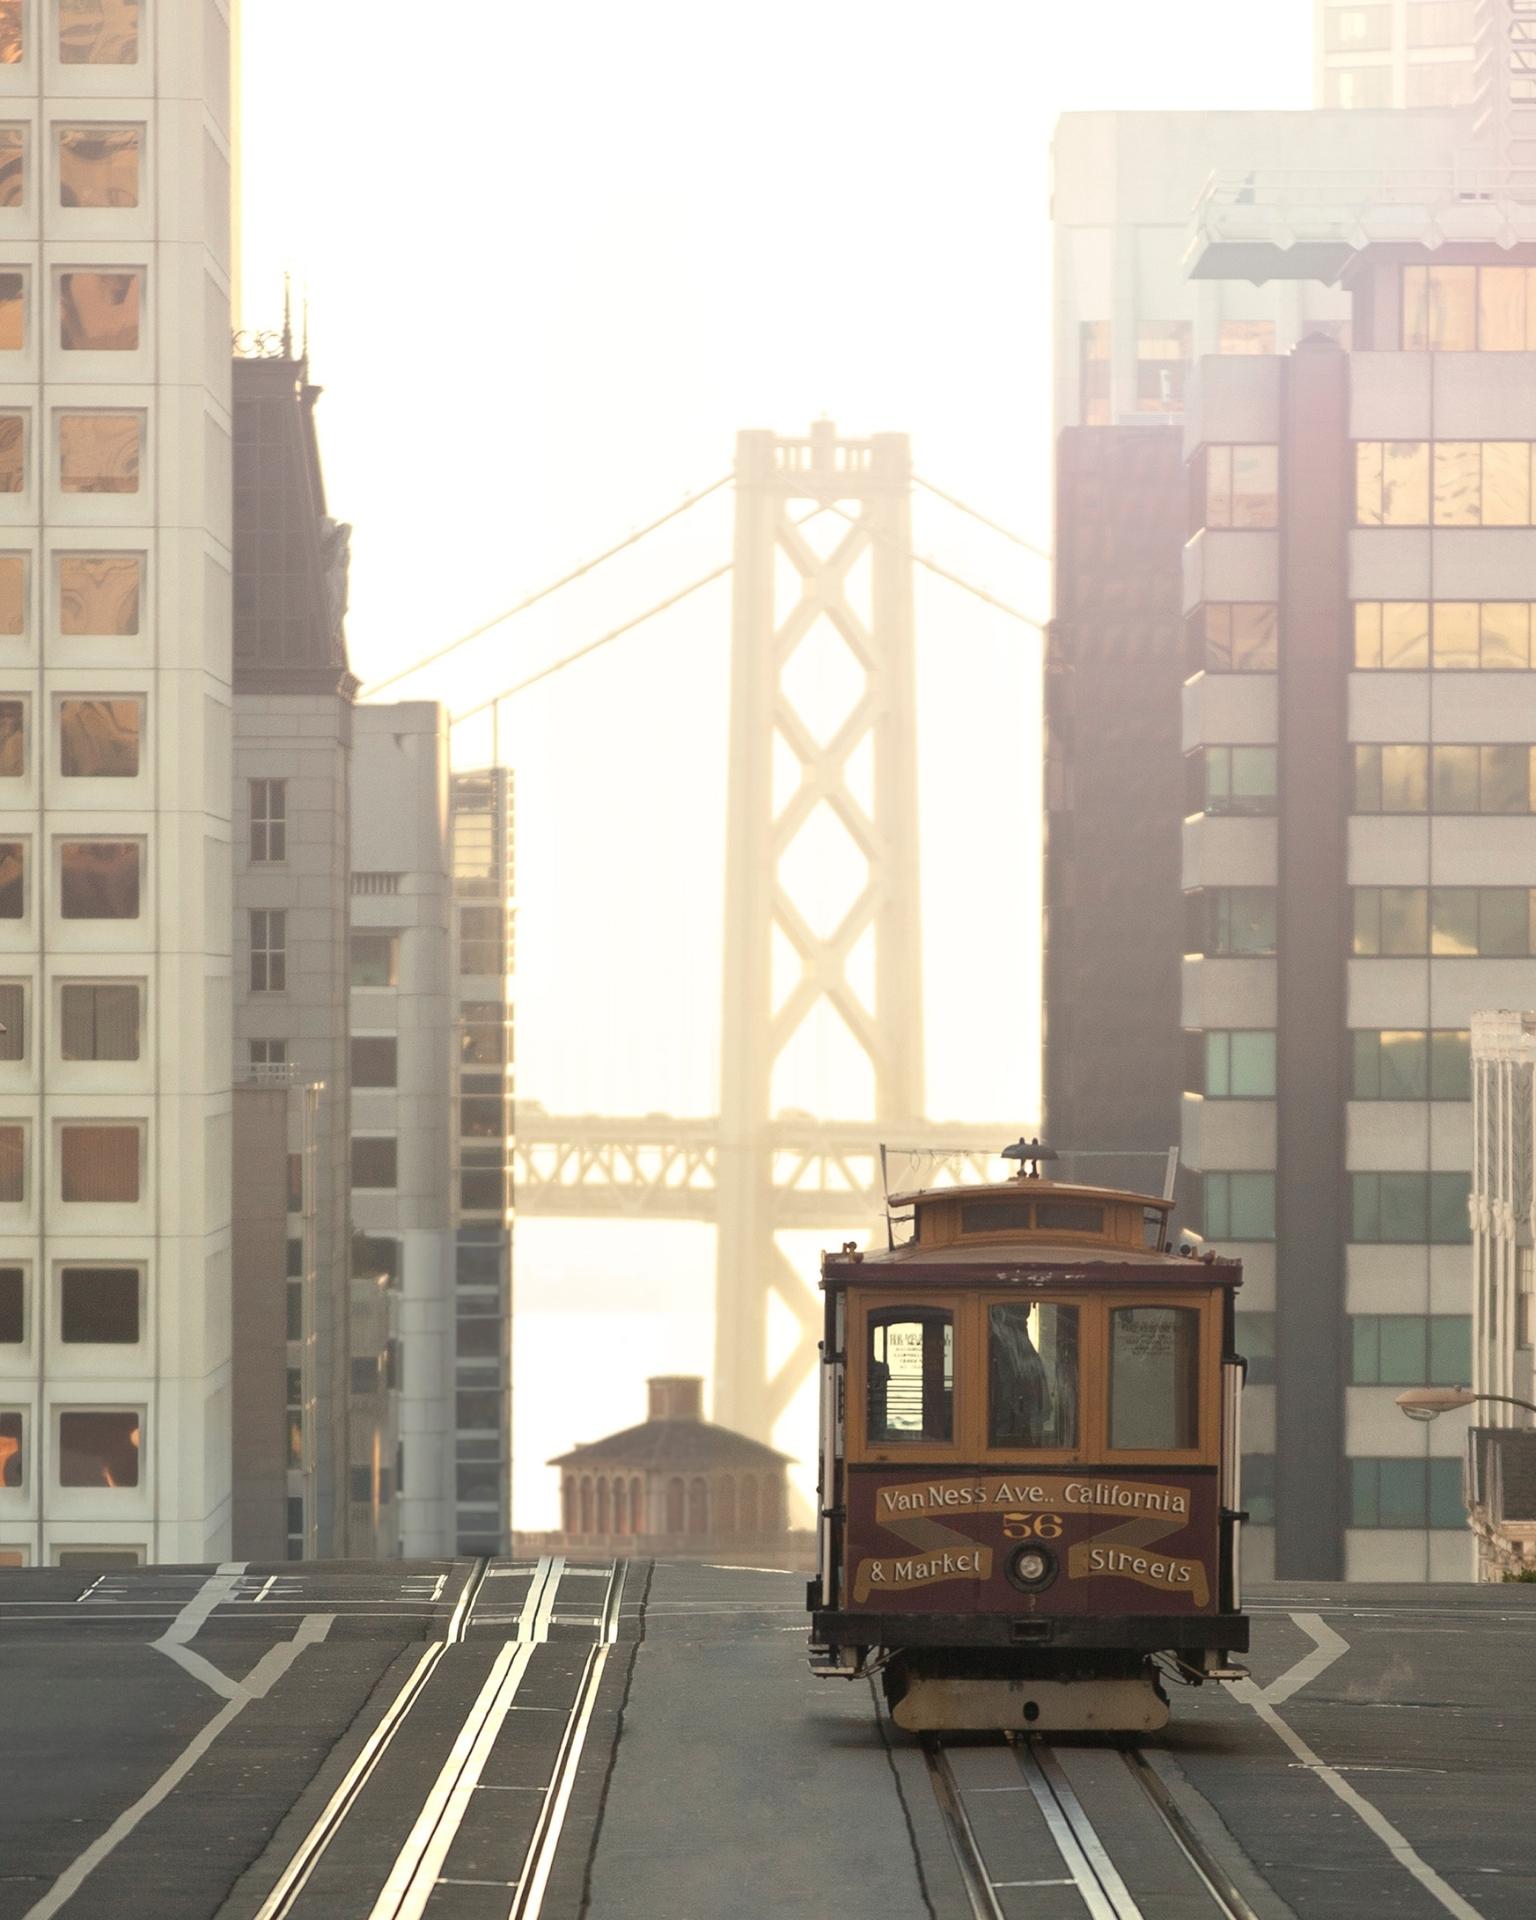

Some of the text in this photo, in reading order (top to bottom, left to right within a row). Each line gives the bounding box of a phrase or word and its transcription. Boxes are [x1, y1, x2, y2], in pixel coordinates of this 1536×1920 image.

[883, 1491, 925, 1512] Van
[928, 1486, 988, 1507] Ness
[1064, 1483, 1186, 1513] California
[1003, 1512, 1063, 1539] 56
[871, 1551, 980, 1582] & Market
[1090, 1549, 1192, 1583] Streets
